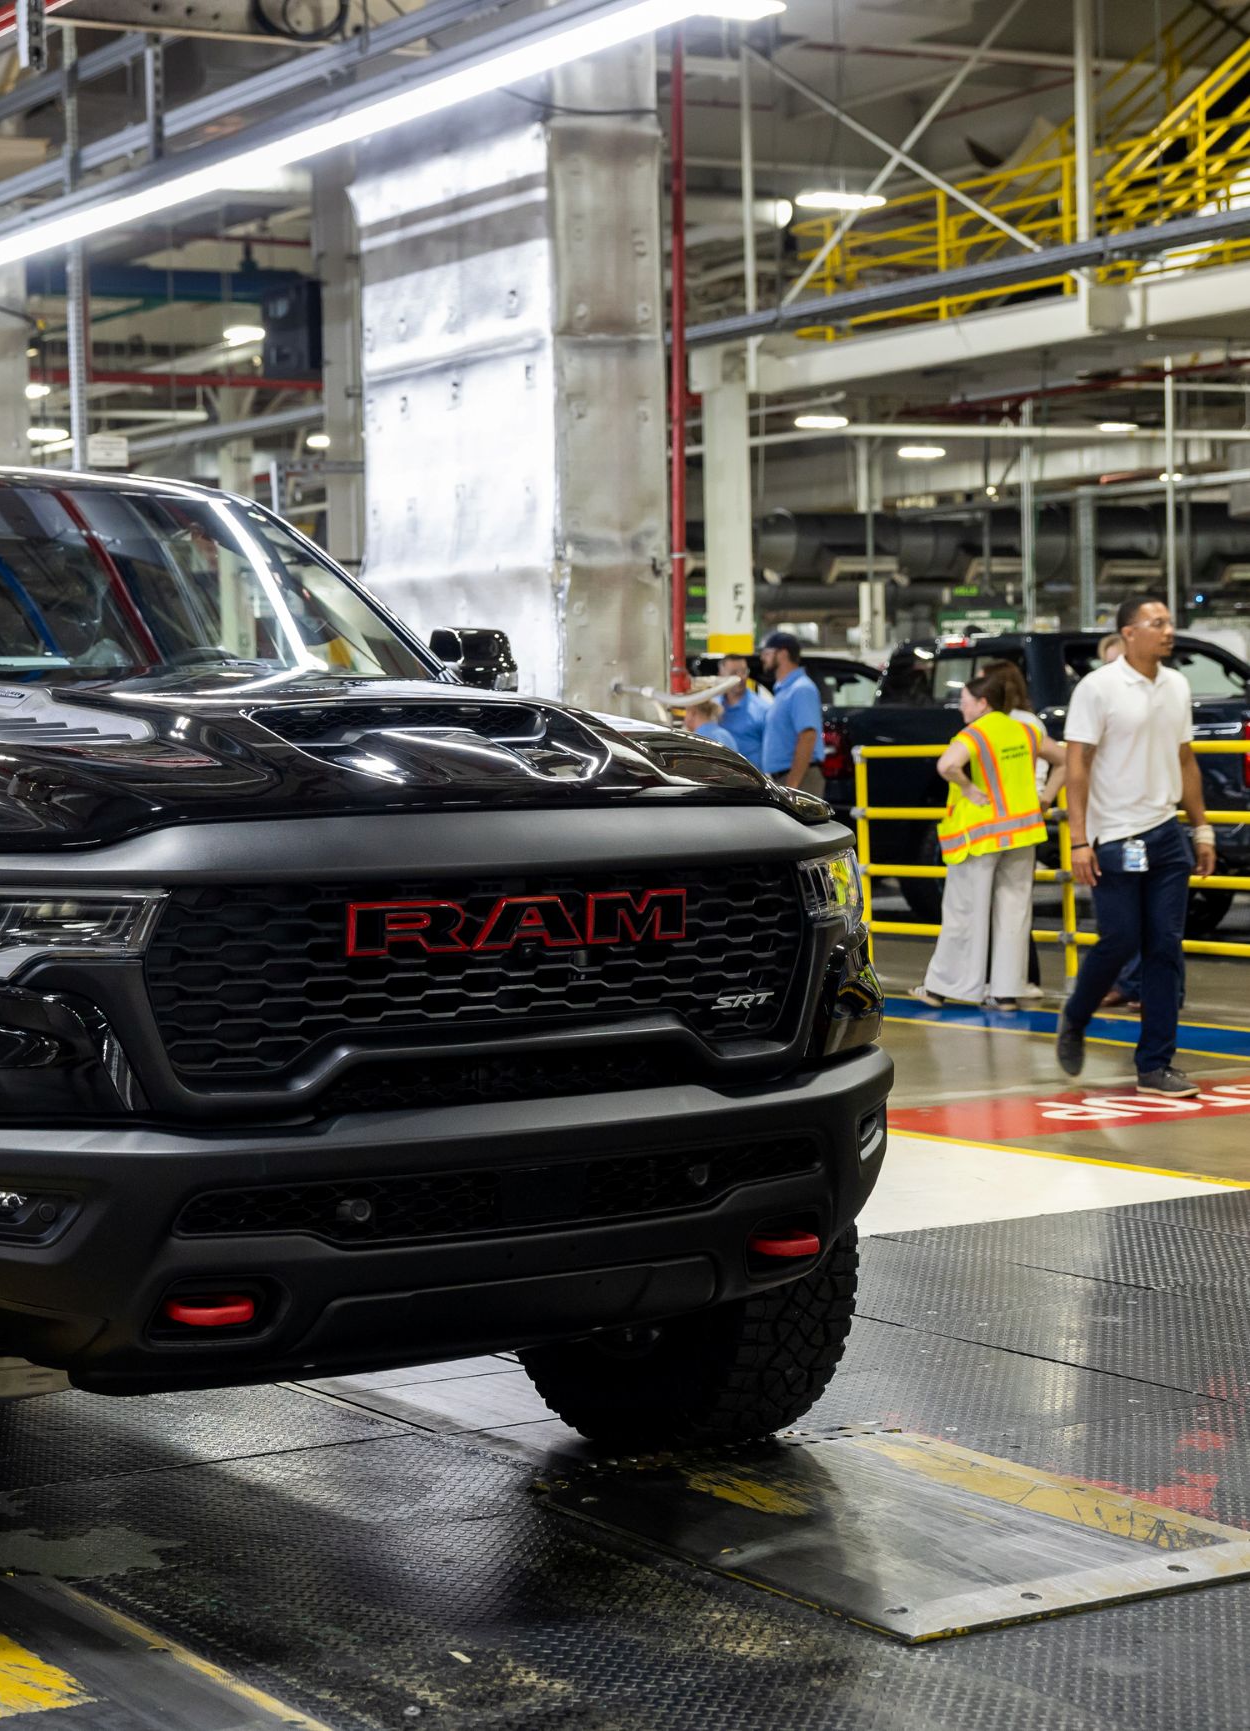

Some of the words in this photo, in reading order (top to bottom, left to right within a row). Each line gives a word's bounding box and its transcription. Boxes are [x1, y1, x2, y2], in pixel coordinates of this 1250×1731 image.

[734, 583, 745, 601] F
[734, 604, 745, 622] 7
[346, 889, 687, 957] RAM
[711, 991, 775, 1010] SRT
